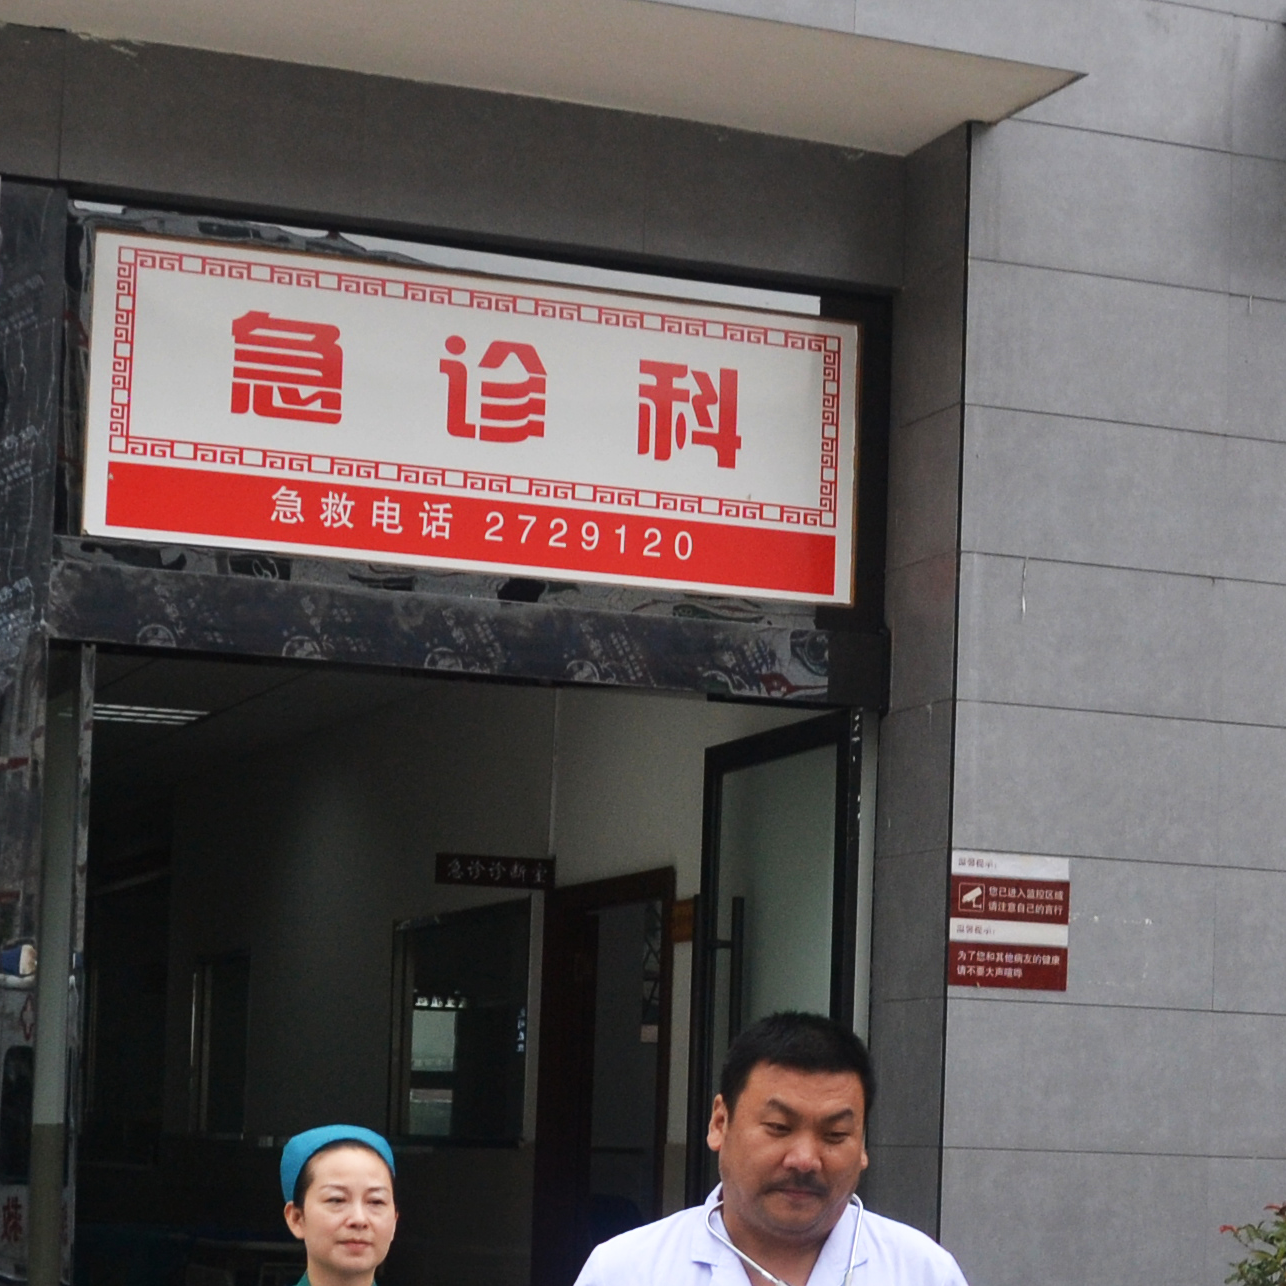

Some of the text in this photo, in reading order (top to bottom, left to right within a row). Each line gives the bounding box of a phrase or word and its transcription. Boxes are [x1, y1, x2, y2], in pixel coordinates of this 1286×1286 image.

[230, 310, 742, 470] 急诊科
[271, 486, 695, 561] 急救电话 2729120
[989, 886, 1063, 900] 您已进入监控区域
[989, 902, 1063, 915] 请注意自己的言行
